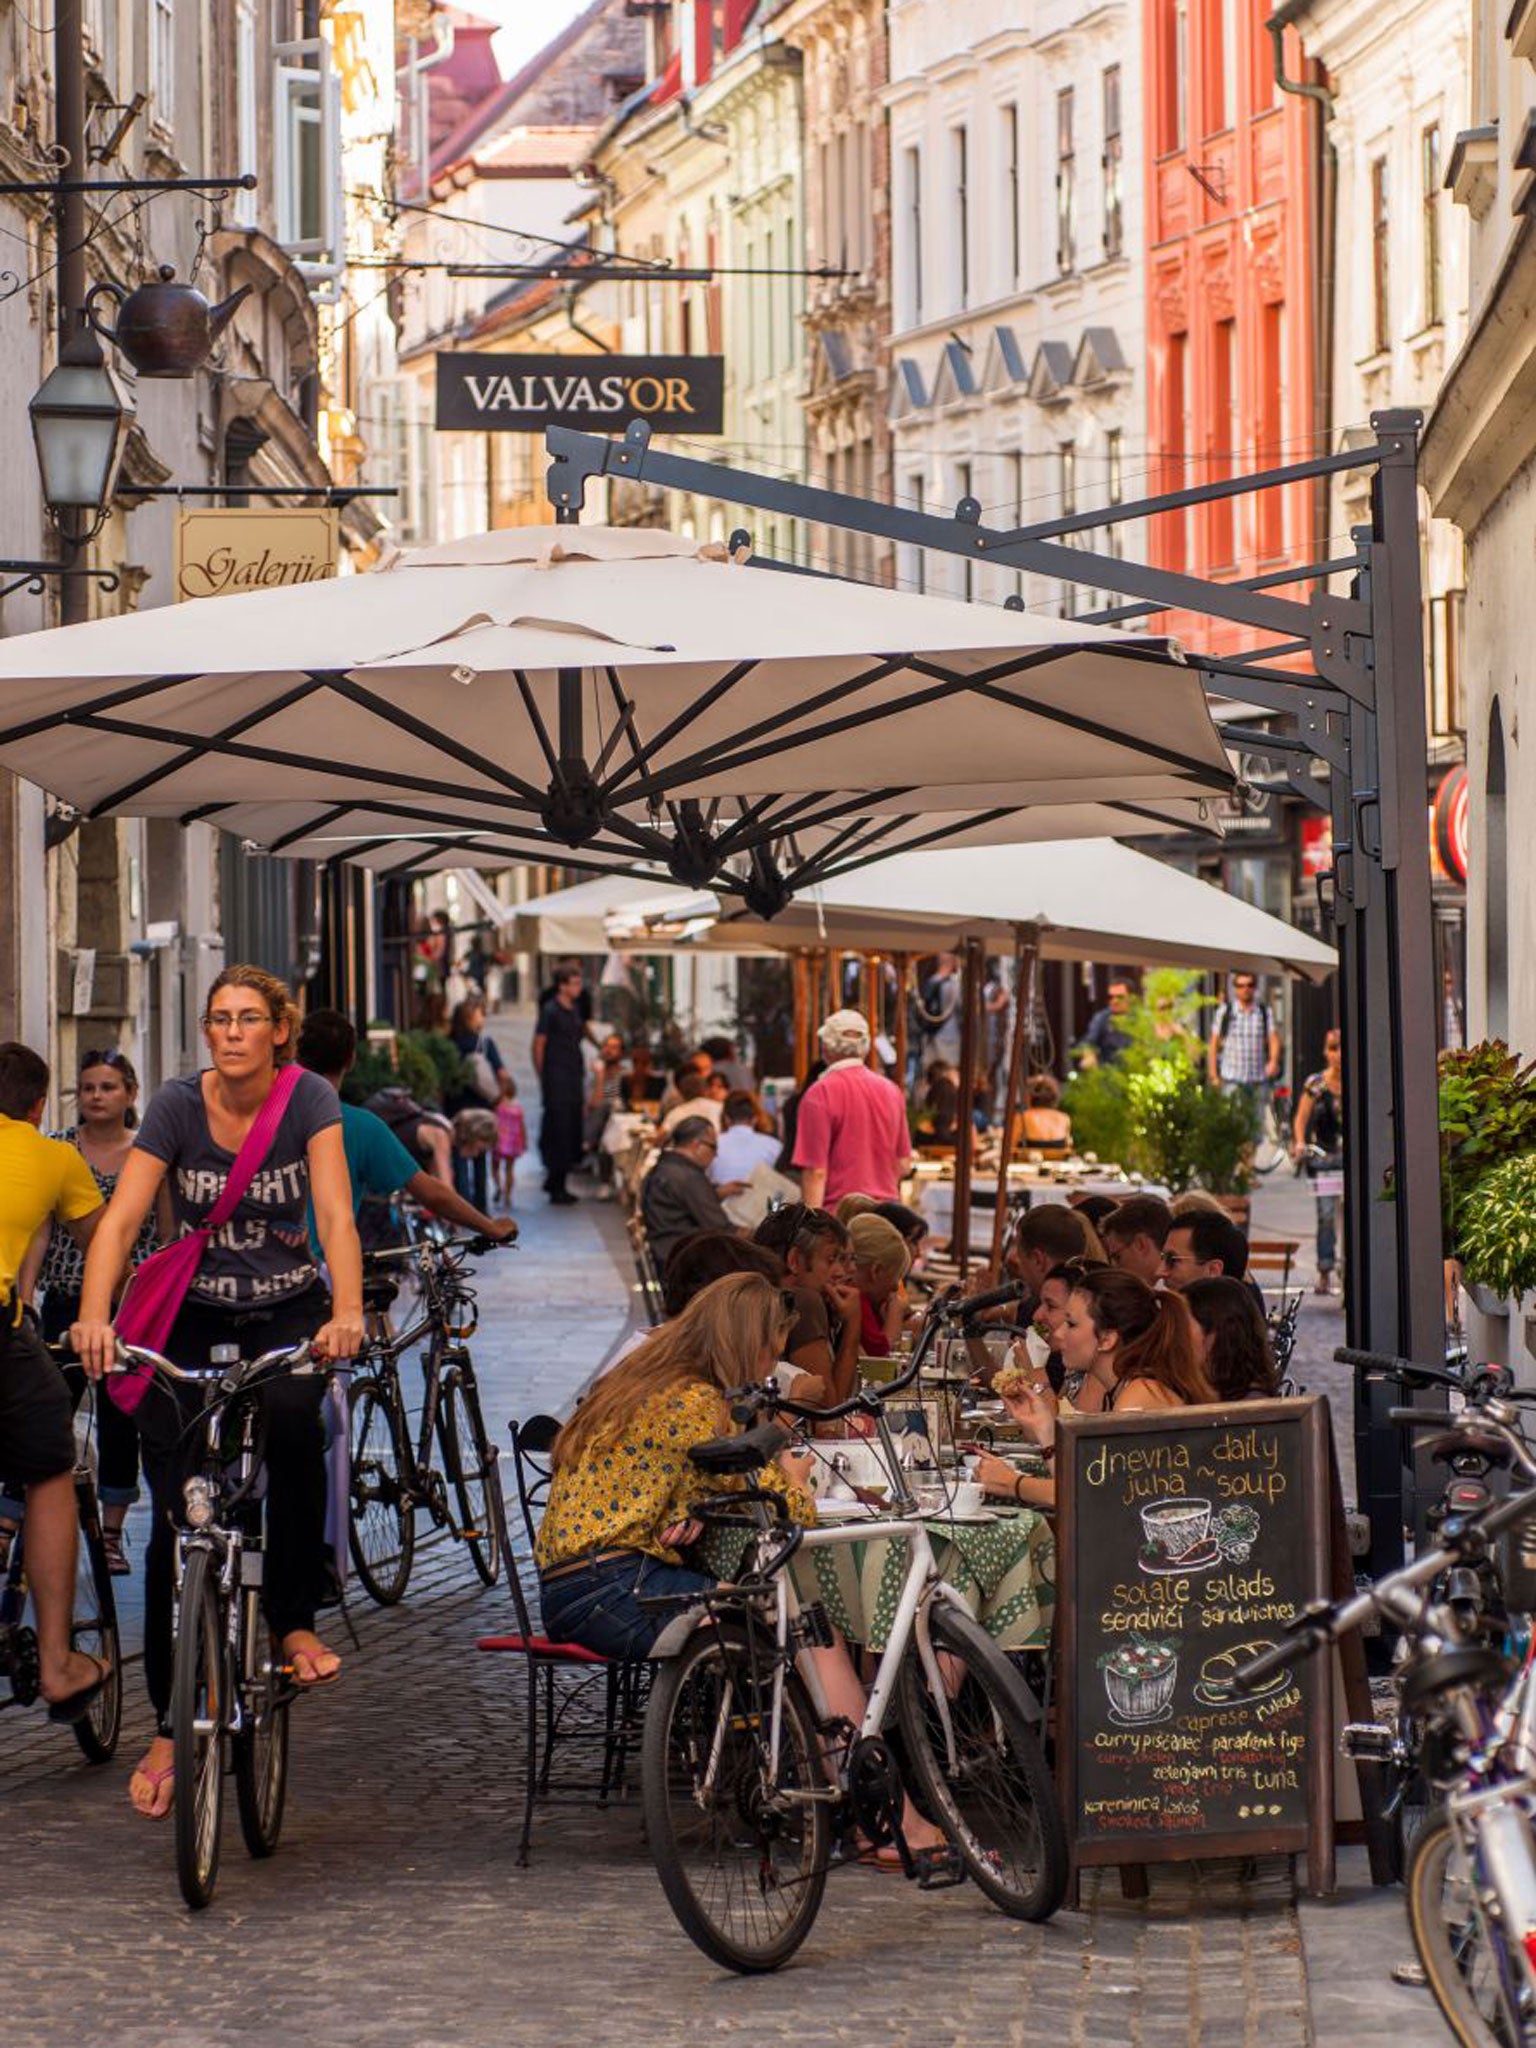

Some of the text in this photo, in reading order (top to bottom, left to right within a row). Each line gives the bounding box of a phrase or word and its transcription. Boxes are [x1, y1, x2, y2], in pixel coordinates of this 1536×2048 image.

[464, 375, 695, 414] VALVAS'OR
[1086, 1428, 1279, 1486] dnevna daily
[1122, 1472, 1287, 1506] juha soup
[1205, 1568, 1276, 1602] salads
[1201, 1601, 1296, 1631] sandwiches
[1094, 1732, 1141, 1755] curry
[1254, 1769, 1300, 1791] tuna
